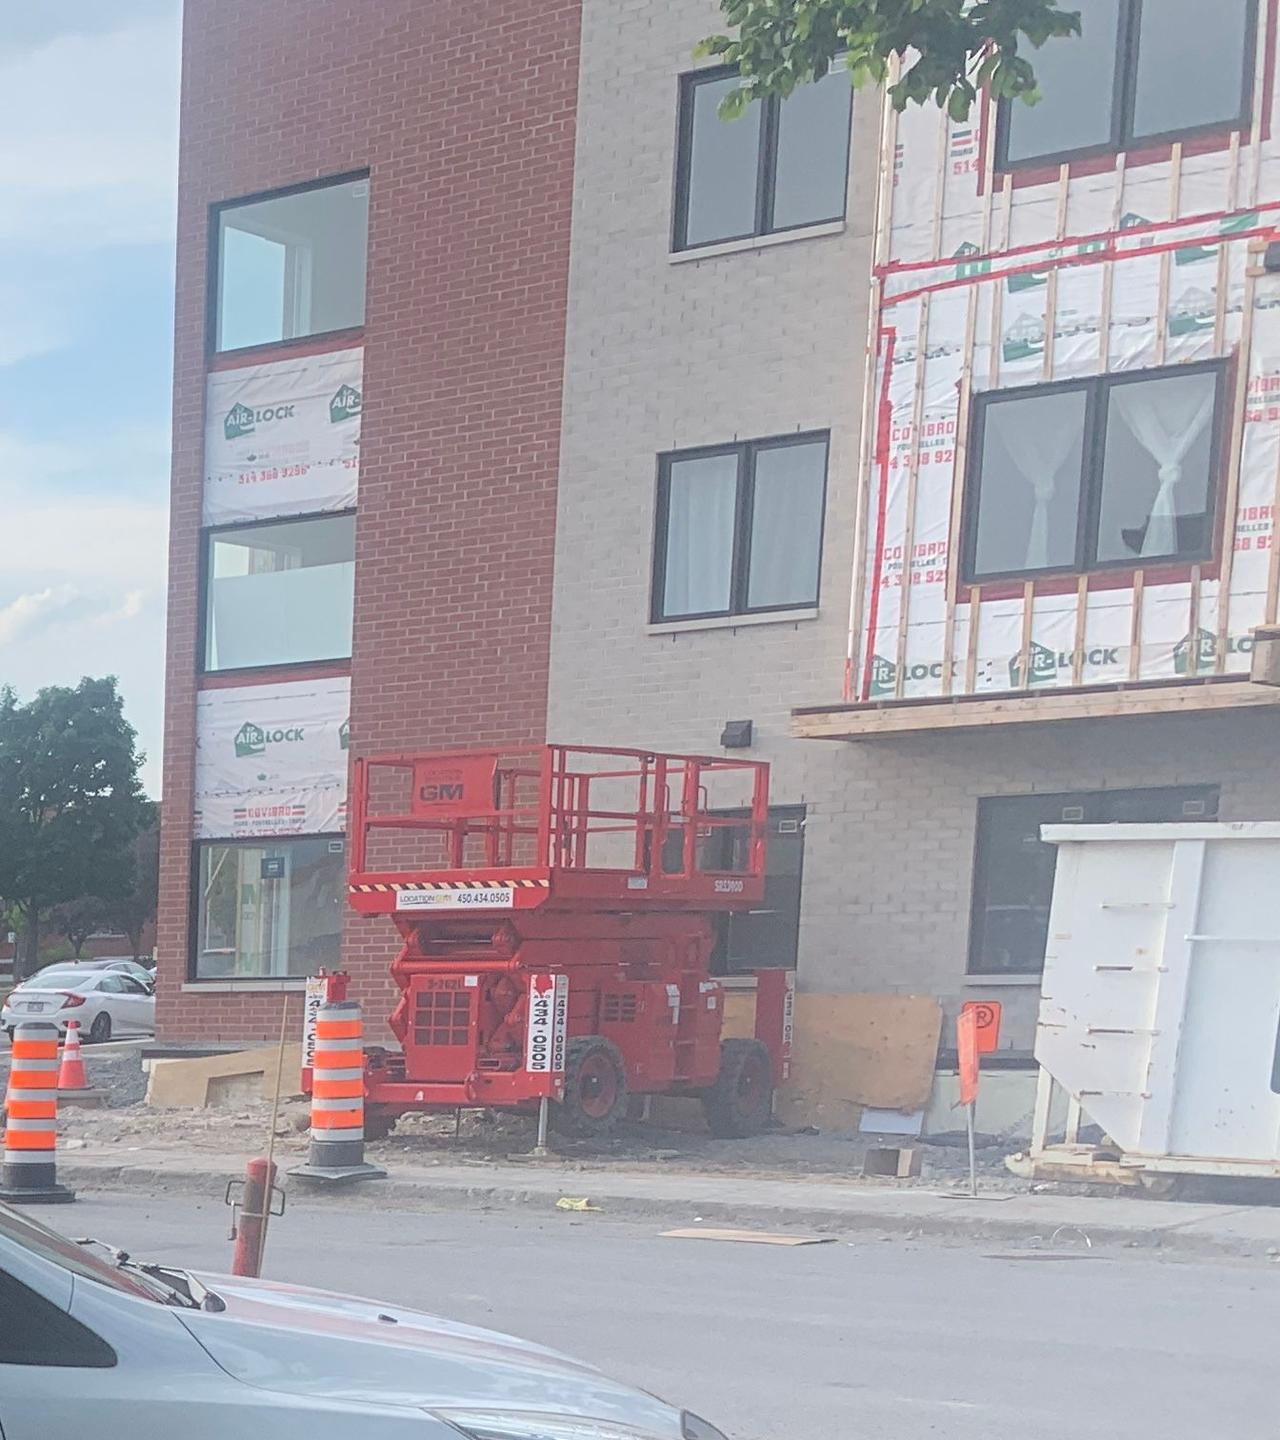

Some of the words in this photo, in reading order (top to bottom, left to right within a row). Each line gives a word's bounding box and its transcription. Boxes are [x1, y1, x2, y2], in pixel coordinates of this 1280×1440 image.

[892, 421, 955, 441] COIBRO
[884, 542, 946, 560] COIBRO
[420, 784, 464, 801] GM
